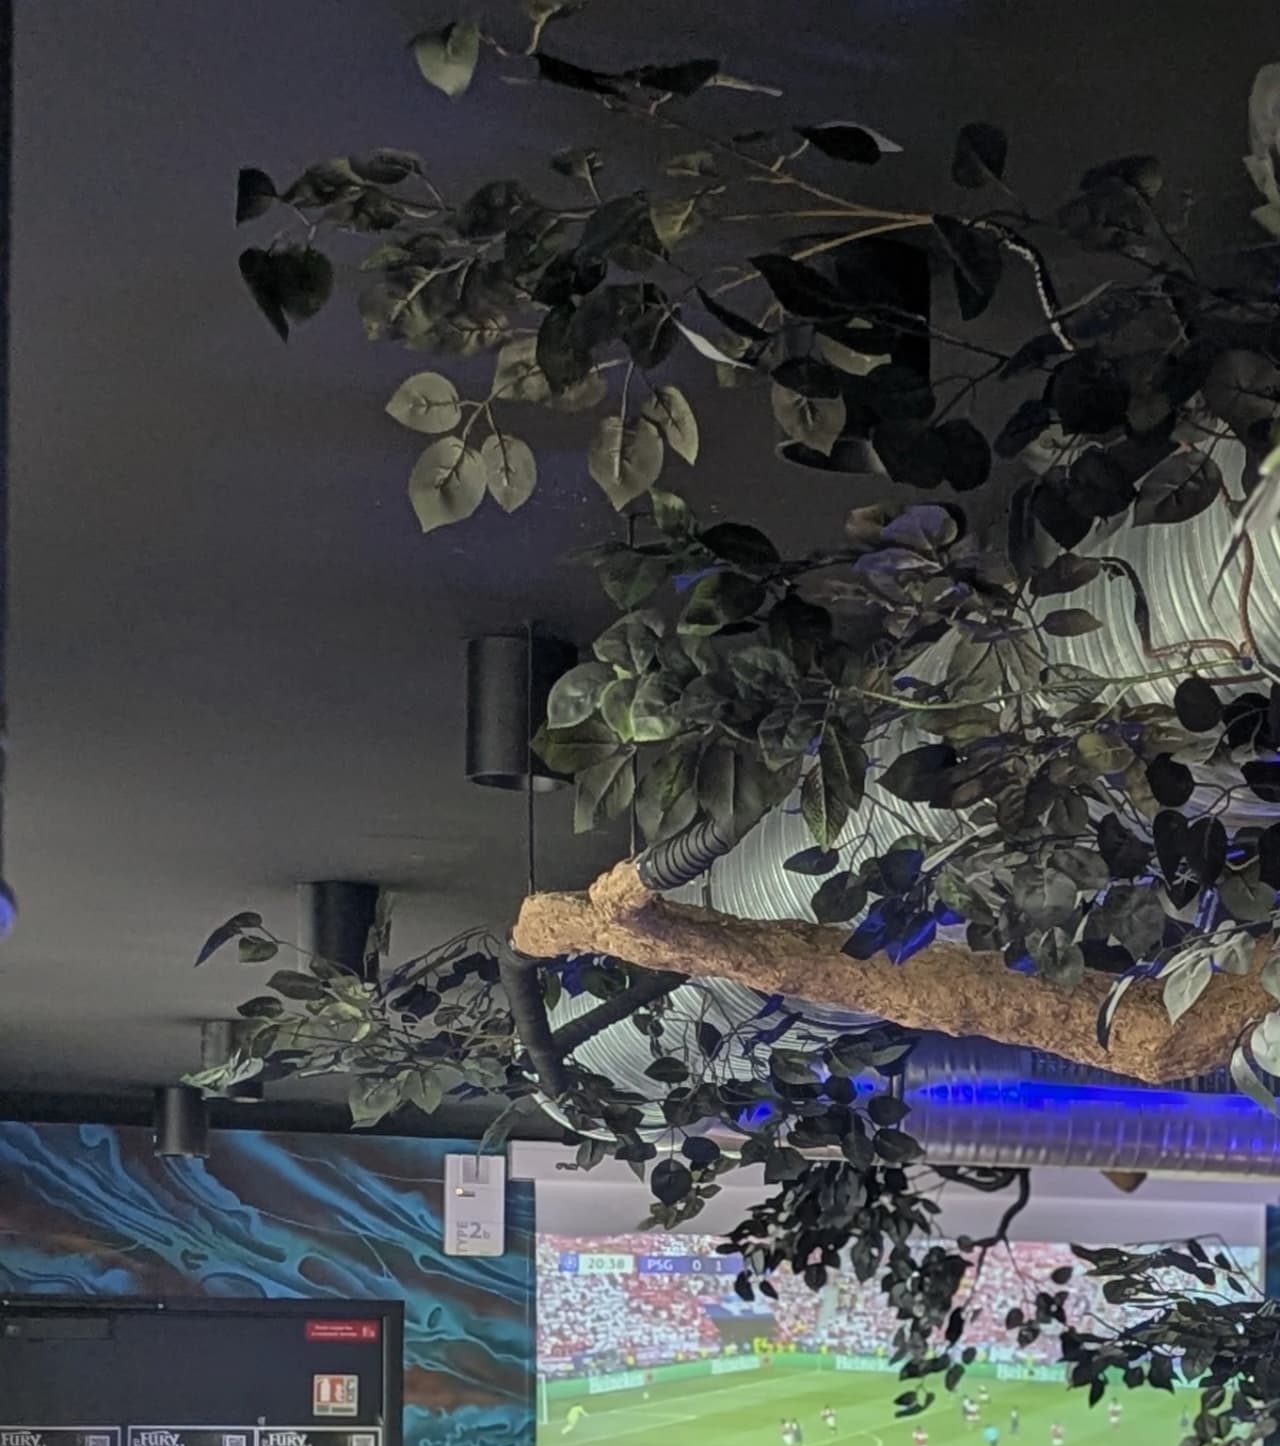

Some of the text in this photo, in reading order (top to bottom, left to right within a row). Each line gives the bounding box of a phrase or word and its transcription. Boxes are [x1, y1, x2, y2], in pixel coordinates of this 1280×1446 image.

[647, 1258, 674, 1271] PSG
[692, 1259, 701, 1272] 0
[715, 1260, 723, 1272] 1
[139, 1431, 181, 1446] FURY
[268, 1432, 308, 1446] FURY
